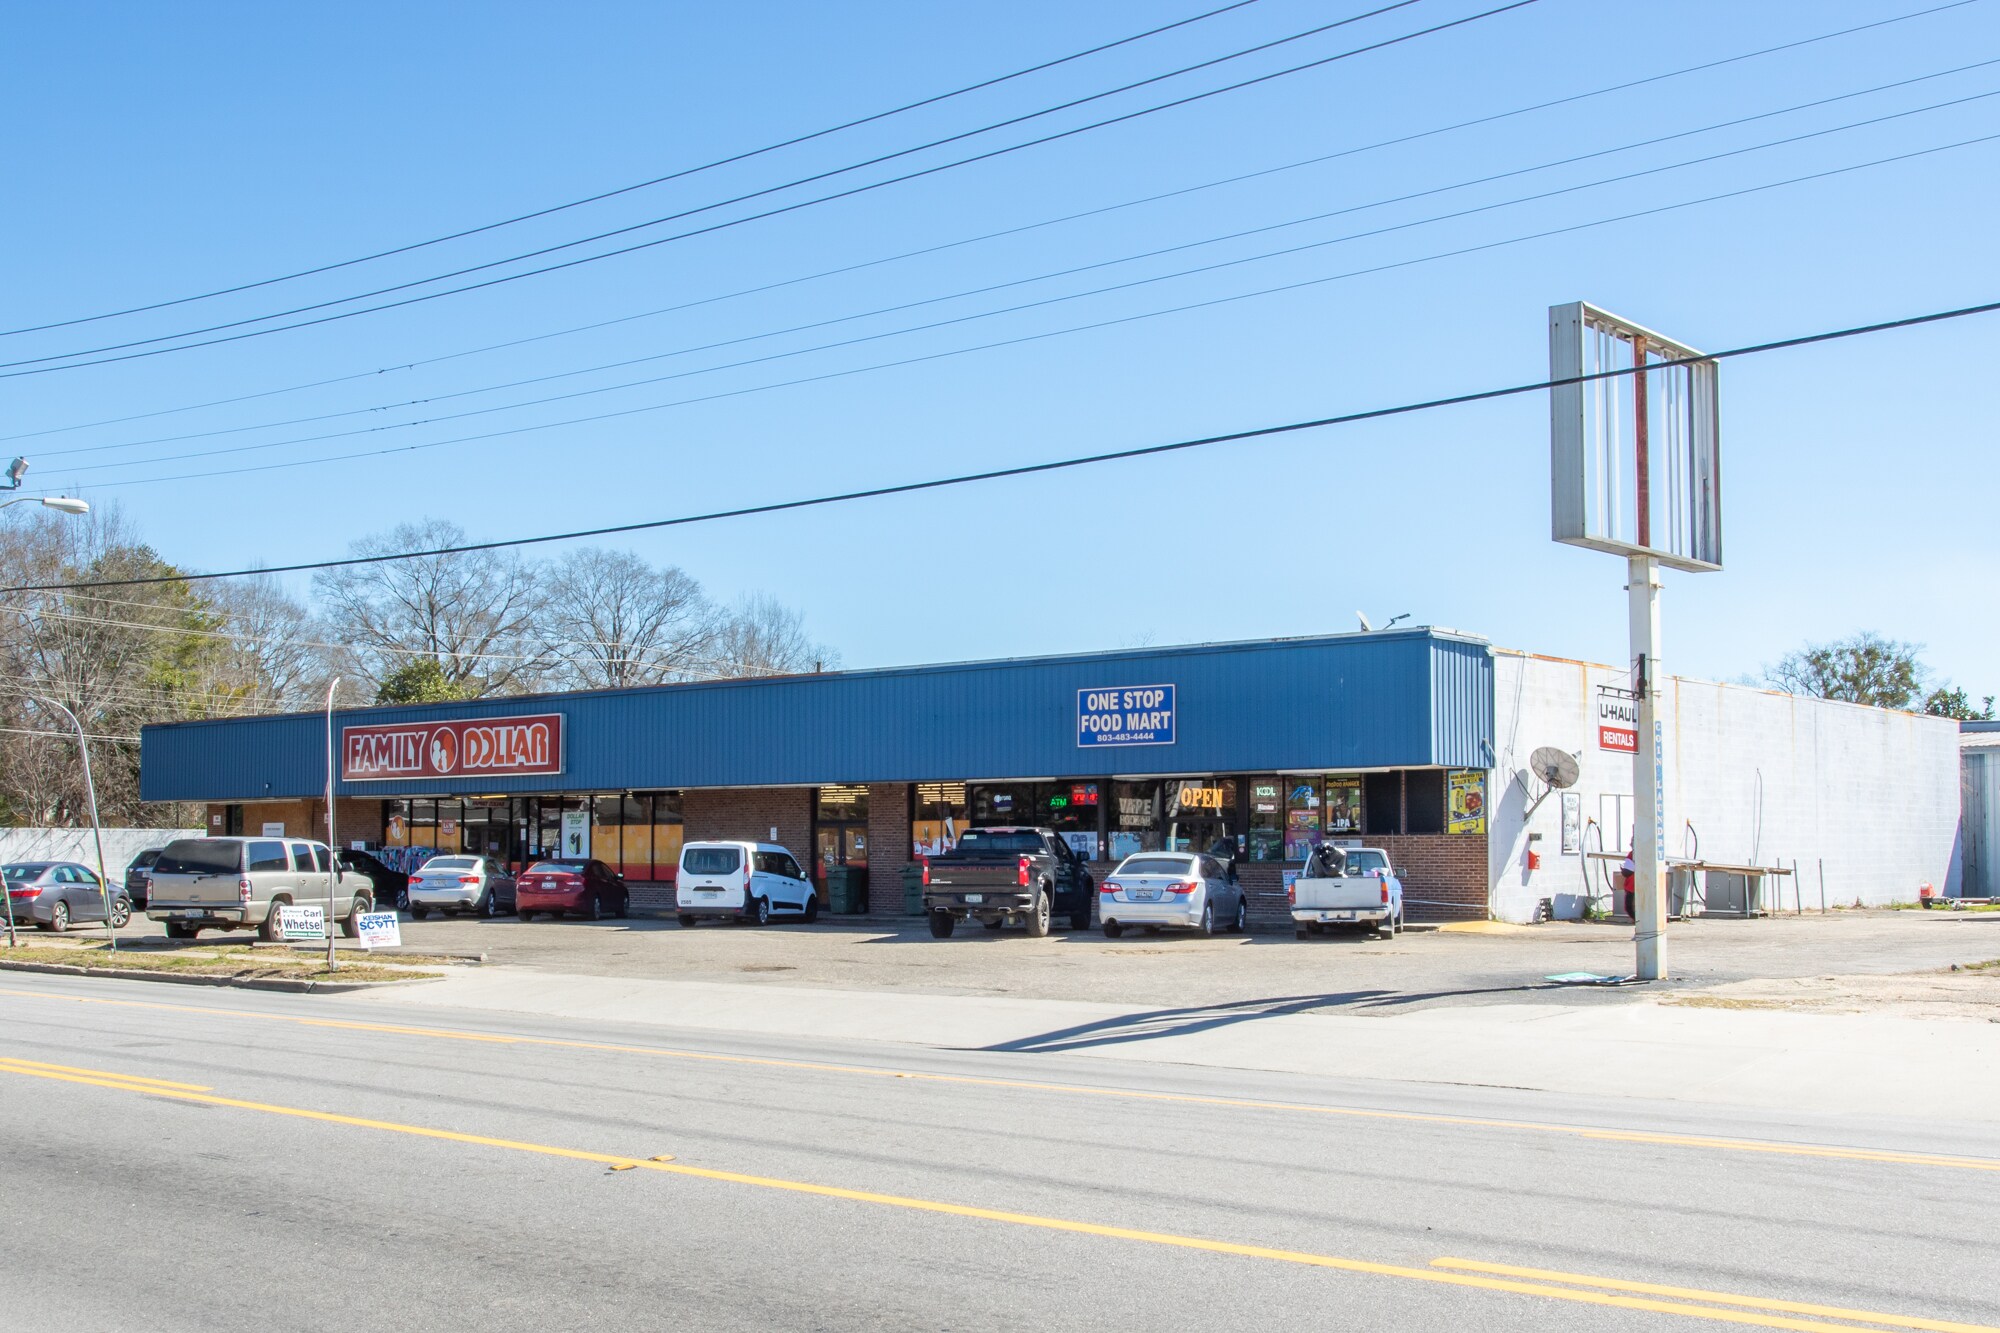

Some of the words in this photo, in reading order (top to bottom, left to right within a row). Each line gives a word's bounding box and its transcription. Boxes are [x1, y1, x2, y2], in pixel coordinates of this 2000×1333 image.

[1087, 692, 1119, 711] ONE
[1123, 689, 1164, 710] STOP
[1081, 713, 1122, 733] FOOD
[1126, 711, 1171, 731] MART
[1096, 732, 1154, 742] 803-483-4444
[1603, 731, 1634, 747] RENTALS
[349, 731, 428, 773] FAMILY
[463, 723, 549, 769] DOLLAR
[1181, 788, 1223, 808] OPEN
[1257, 787, 1276, 796] KOOL
[1050, 798, 1067, 807] ATM
[1119, 798, 1152, 815] VAPE
[1336, 818, 1351, 828] IPA
[303, 909, 322, 917] Carl
[283, 919, 323, 930] Whetsel
